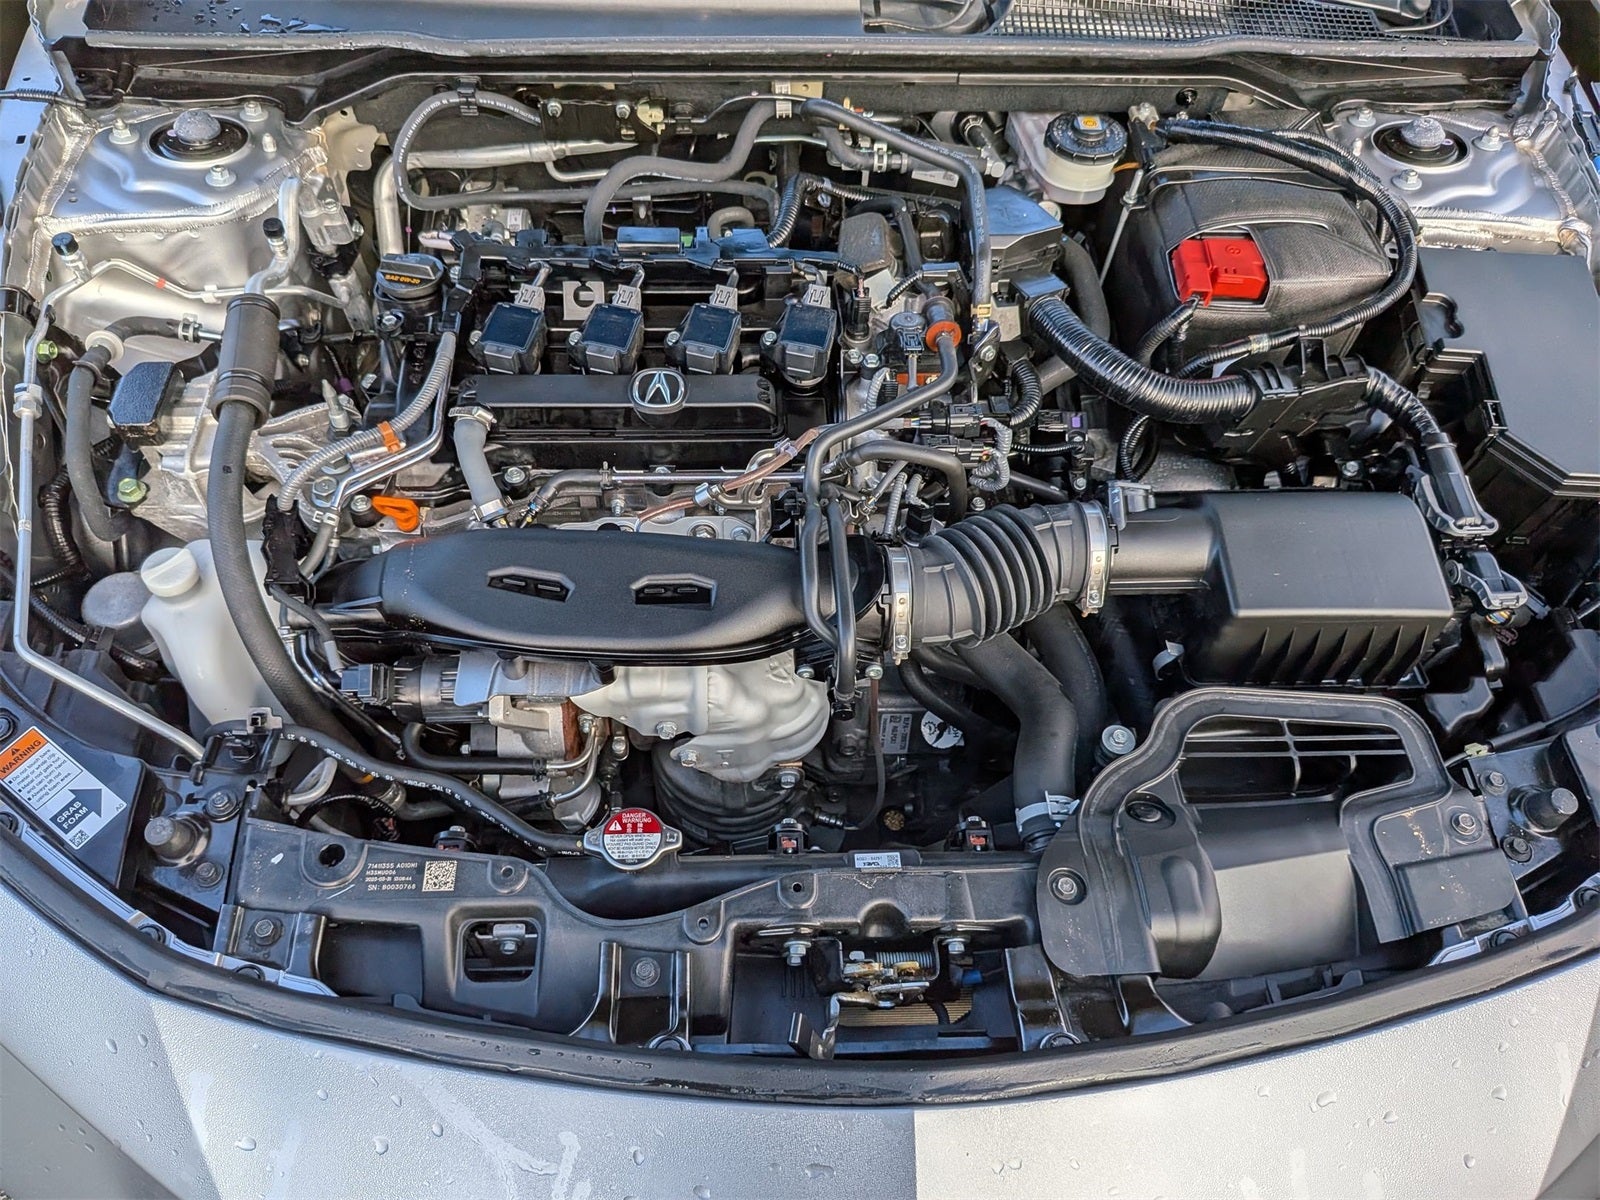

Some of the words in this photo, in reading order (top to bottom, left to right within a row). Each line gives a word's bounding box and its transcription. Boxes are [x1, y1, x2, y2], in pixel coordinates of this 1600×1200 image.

[0, 740, 41, 774] WARNING
[57, 801, 81, 823] GRAB
[63, 806, 88, 829] FOAM
